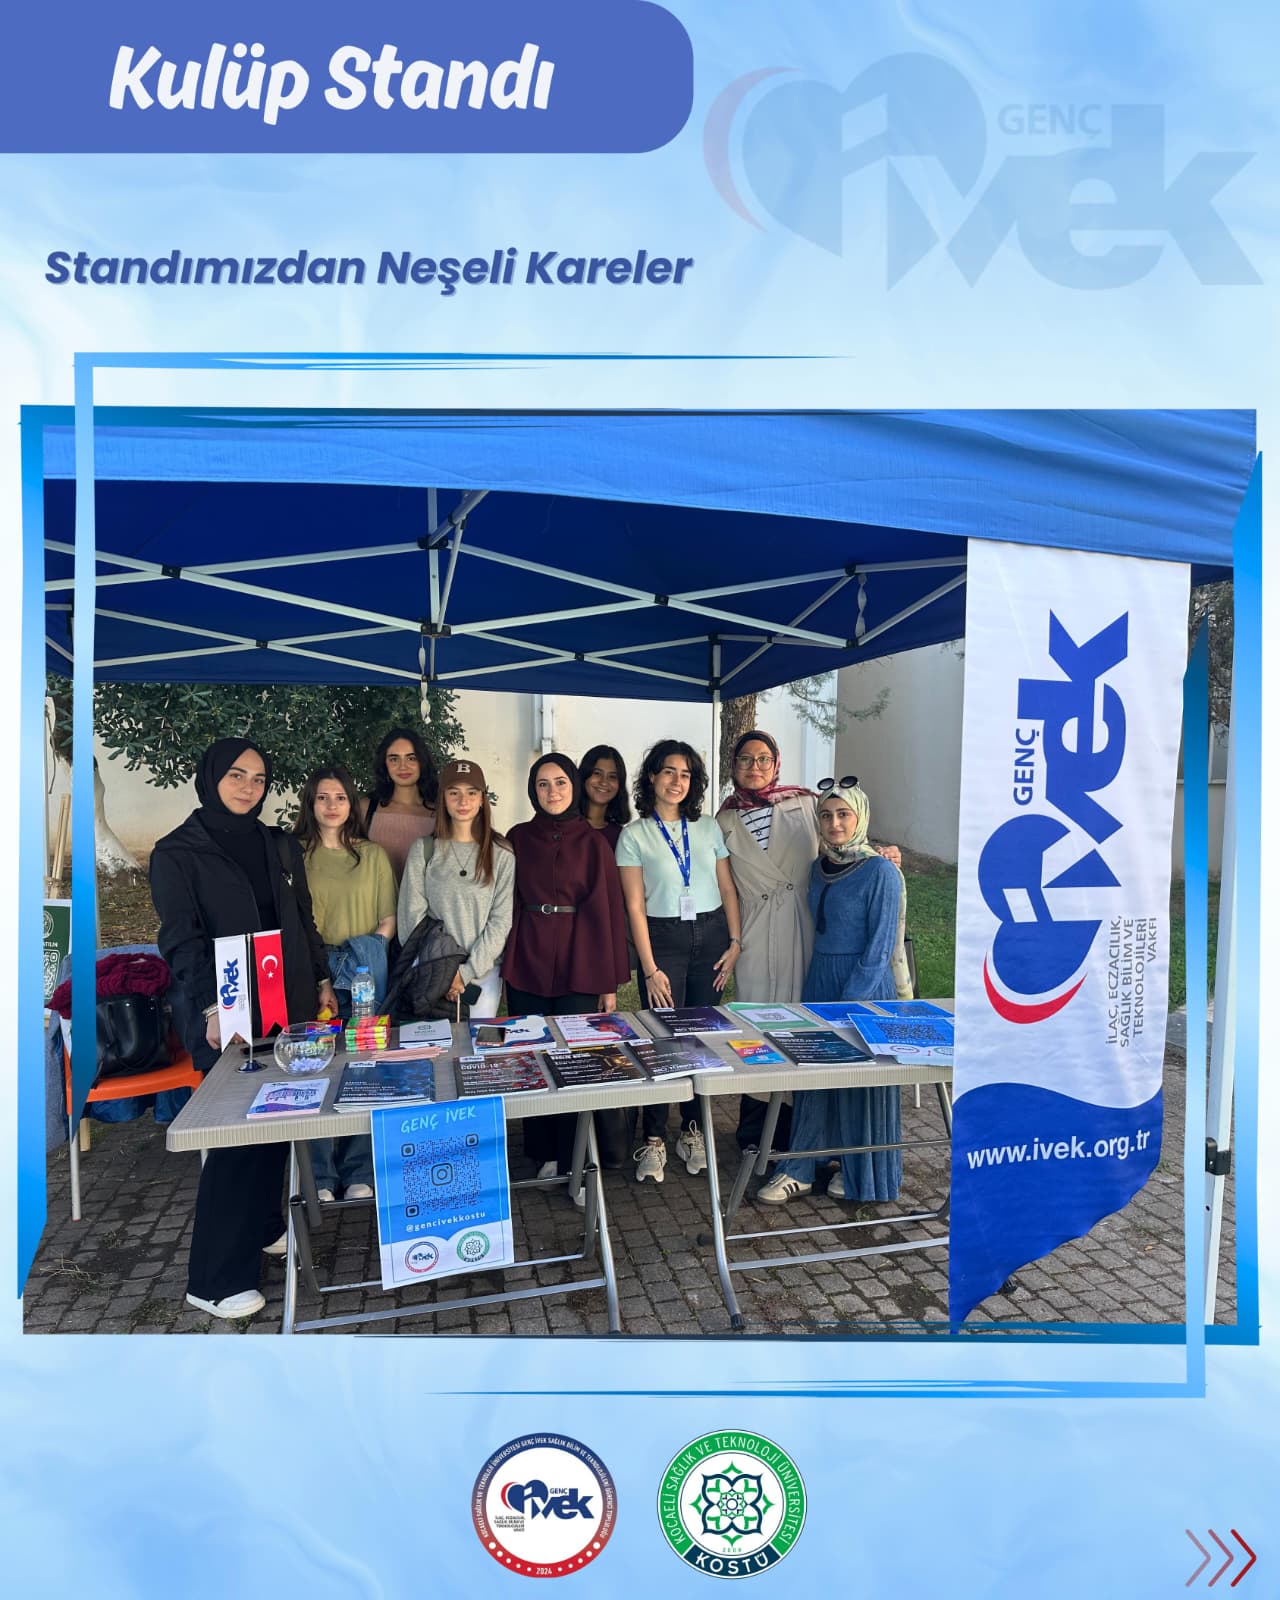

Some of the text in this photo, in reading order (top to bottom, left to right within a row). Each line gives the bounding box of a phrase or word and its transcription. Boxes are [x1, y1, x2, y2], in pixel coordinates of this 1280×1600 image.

[456, 763, 471, 773] B
[1013, 727, 1041, 806] GENÇ
[1108, 915, 1122, 1000] ECZACILIK,
[1147, 917, 1157, 963] VAKFI
[1119, 919, 1134, 1047] SAĞLIK BİLİM VE
[1132, 918, 1147, 1038] TEKNOLOJİLERİ
[400, 1105, 477, 1134] GENÇ İVEK
[967, 1129, 1150, 1170] www.ivek.org.tr
[405, 1211, 486, 1233] @gencivekkostu
